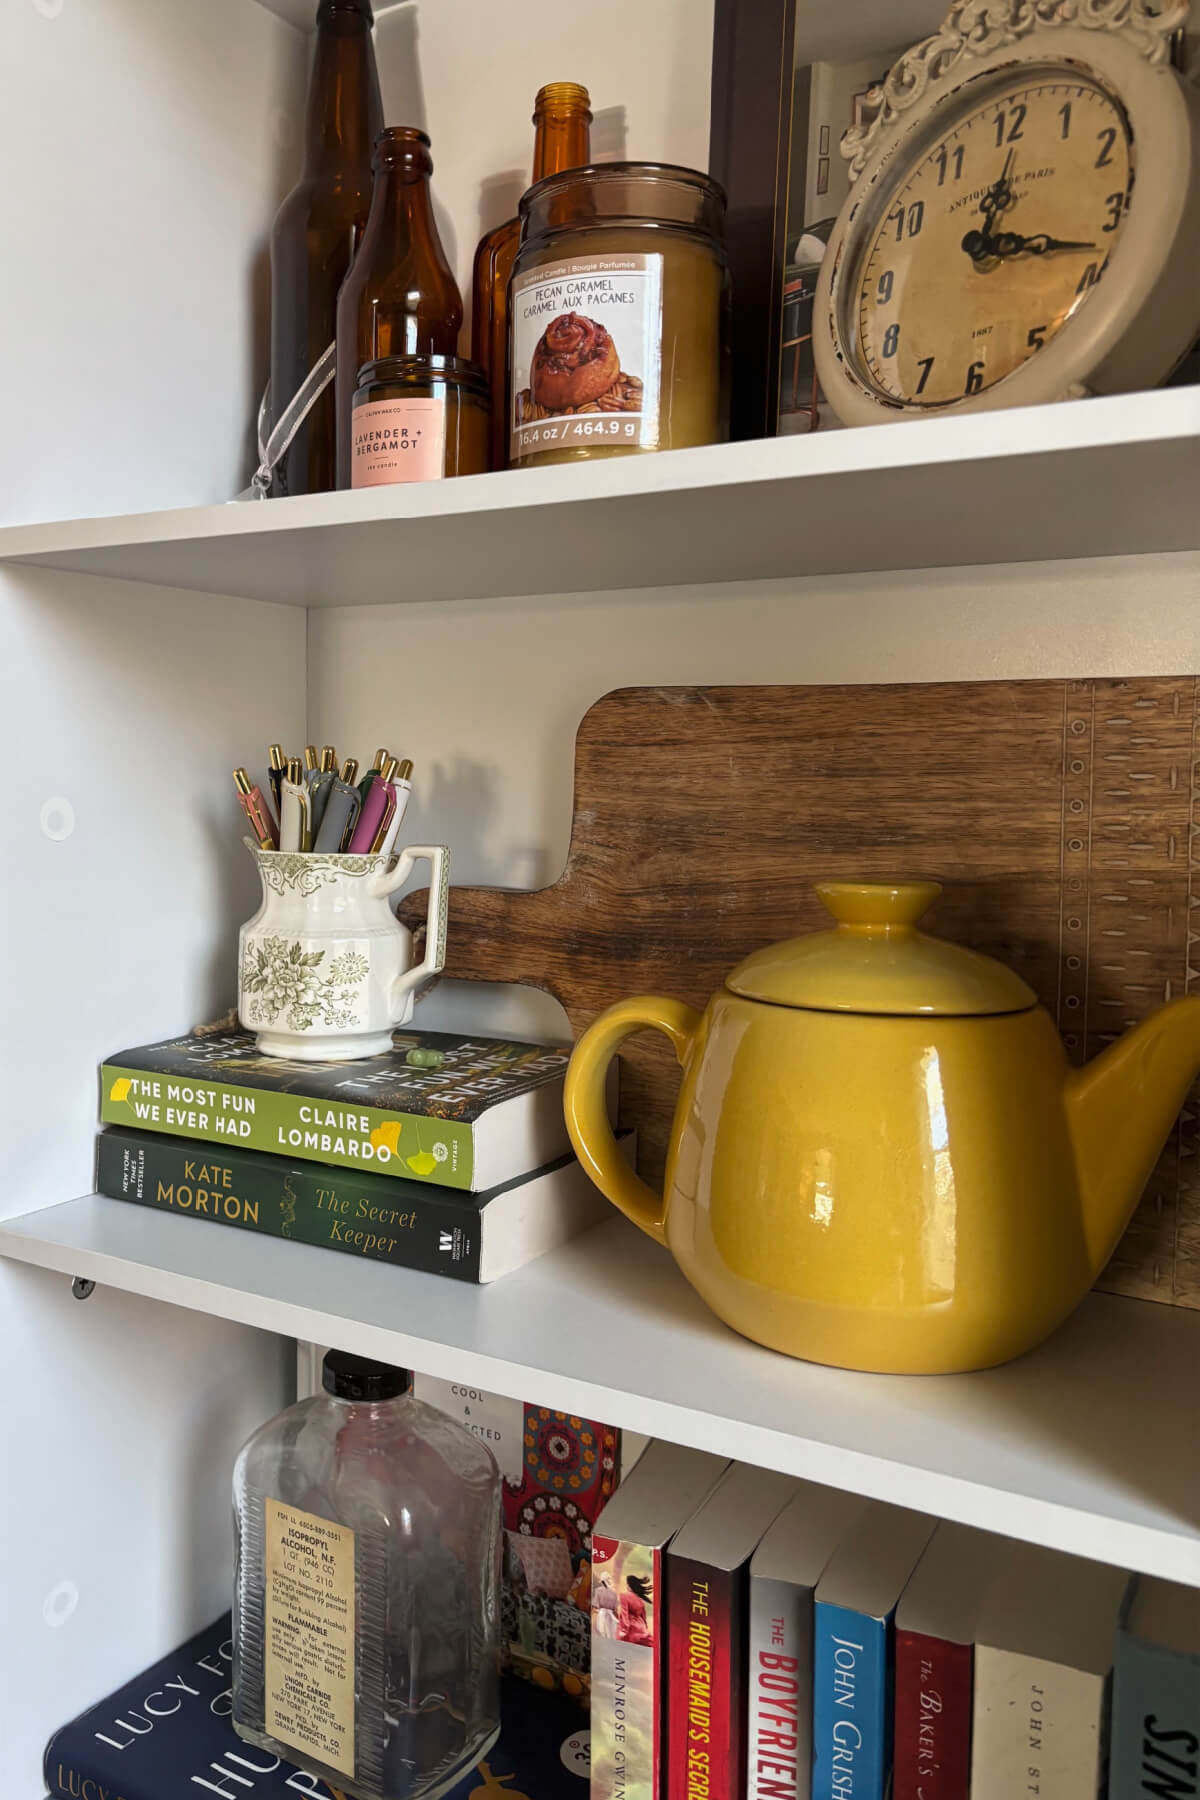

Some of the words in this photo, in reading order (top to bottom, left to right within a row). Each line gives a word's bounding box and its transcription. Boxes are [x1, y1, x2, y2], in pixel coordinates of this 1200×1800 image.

[993, 104, 1027, 148] 12
[1058, 102, 1072, 140] 1
[1095, 128, 1117, 169] 2
[936, 144, 965, 186] 11
[889, 200, 924, 242] 10
[1102, 192, 1123, 232] 3
[571, 262, 598, 273] Bougie
[535, 286, 563, 302] PECAN
[566, 280, 614, 294] CARAMEL
[877, 271, 894, 305] 9
[523, 300, 557, 319] CARAMEL
[562, 295, 583, 308] AUX
[587, 292, 635, 305] PACANES
[882, 324, 900, 359] 8
[1028, 326, 1047, 352] 5
[915, 357, 935, 395] 7
[965, 361, 985, 394] 6
[355, 428, 409, 446] LAVENDER
[356, 440, 418, 456] BERGAMOT
[519, 430, 539, 446] 16.4
[542, 428, 558, 440] oz
[573, 421, 620, 436] 464.9
[624, 423, 635, 437] g
[335, 1070, 411, 1088] THE
[400, 1070, 472, 1090] FUN
[457, 1055, 517, 1070] WE
[427, 1077, 516, 1103] EVER
[502, 1055, 569, 1077] HAD
[131, 1079, 161, 1099] THE
[171, 1085, 216, 1107] MOST
[222, 1093, 256, 1115] FUN
[135, 1101, 160, 1122] WE
[166, 1107, 208, 1130] EVER
[215, 1117, 251, 1138] HAD
[299, 1106, 370, 1134] CLAIRE
[278, 1126, 392, 1164] LOMBARDO
[184, 1161, 233, 1189] KATE
[157, 1183, 260, 1225] MORTON
[315, 1188, 350, 1214] The
[355, 1197, 417, 1230] Secret
[330, 1219, 398, 1254] Keeper
[451, 1385, 484, 1403] COOL
[464, 1405, 471, 1416] &
[281, 1537, 317, 1558] ALCOHOL,
[321, 1553, 336, 1566] N.F.
[288, 1527, 328, 1551] ISOPROPYL
[591, 1547, 609, 1560] P.S.
[283, 1561, 296, 1573] LOT
[299, 1567, 312, 1580] NO.
[316, 1575, 333, 1588] 2110
[304, 1558, 319, 1569] (946
[322, 1564, 335, 1576] CC)
[691, 1581, 709, 1617] THE
[288, 1613, 328, 1636] FLAMMABLE
[771, 1617, 785, 1647] THE
[322, 1641, 347, 1656] external
[295, 1670, 309, 1681] MFD.
[312, 1677, 320, 1687] by
[324, 1665, 335, 1676] Not
[337, 1670, 346, 1680] for
[687, 1621, 712, 1744] HOUSEMAID'S
[831, 1634, 864, 1710] JOHN
[920, 1660, 932, 1682] The
[285, 1674, 304, 1689] UNION
[306, 1685, 331, 1702] CARBIDE
[285, 1682, 317, 1703] CHEMICALS
[319, 1698, 331, 1710] CO.
[614, 1658, 627, 1744] MINROSE
[94, 1674, 200, 1750] LUCY
[272, 1692, 285, 1703] NEW
[286, 1700, 301, 1713] YORK
[313, 1713, 327, 1725] NEW
[329, 1720, 346, 1734] YORK
[293, 1695, 308, 1707] PARK
[311, 1704, 335, 1720] AVENUE
[1028, 1685, 1044, 1751] JOHN
[274, 1719, 296, 1735] GRAND
[296, 1722, 327, 1742] PRODUCTS
[330, 1737, 341, 1749] CO.
[311, 1721, 319, 1731] by
[918, 1689, 943, 1778] BAKER'S
